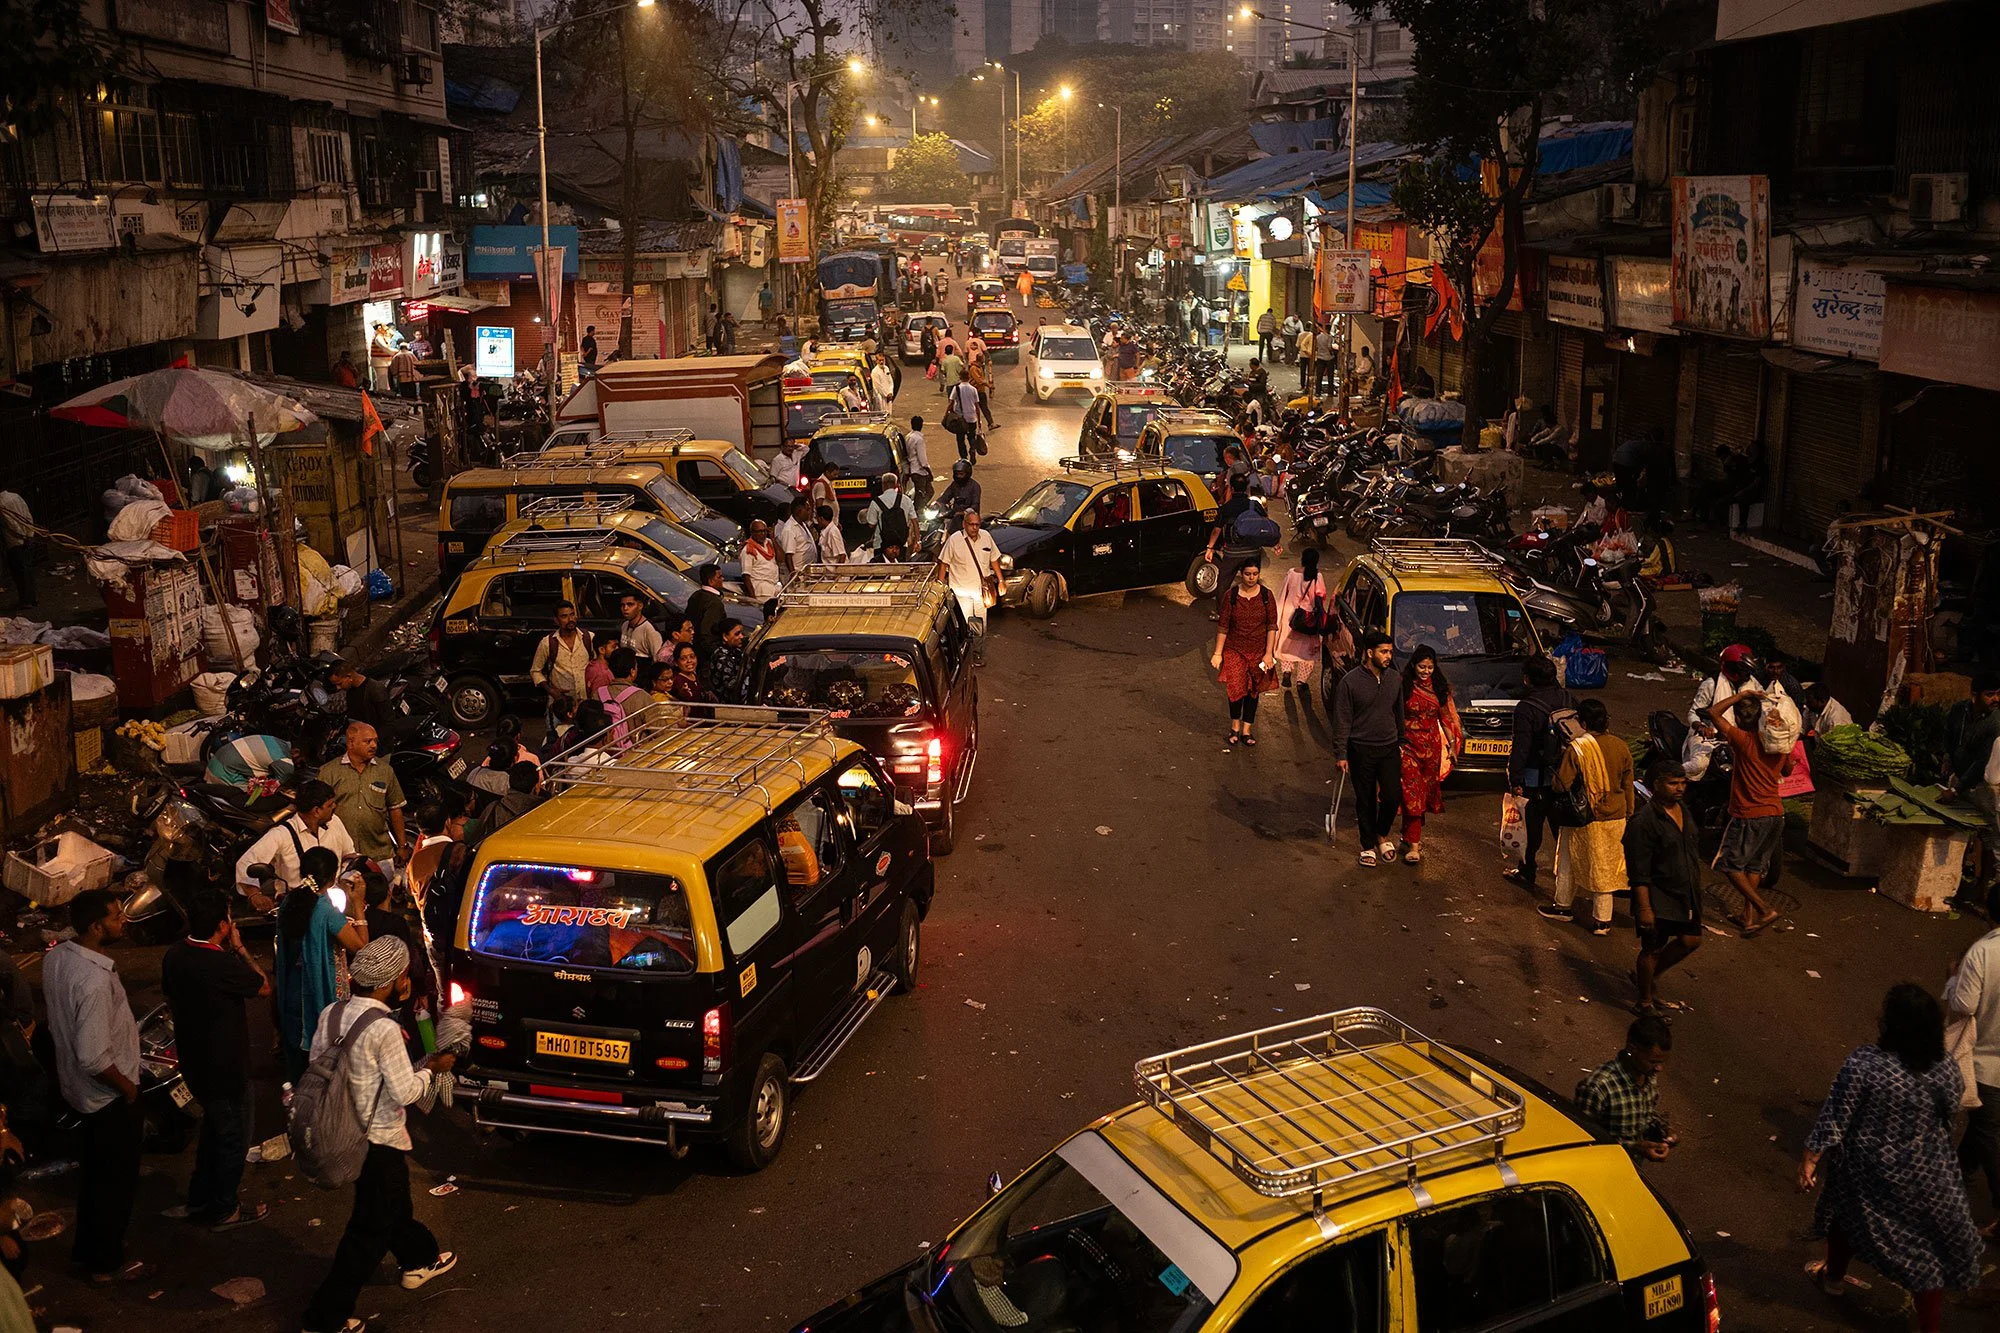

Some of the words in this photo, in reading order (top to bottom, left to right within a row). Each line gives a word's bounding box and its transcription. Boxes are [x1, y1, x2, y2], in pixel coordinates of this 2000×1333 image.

[1812, 293, 1861, 321] सुरेन्द्र
[291, 484, 331, 502] TATIONARY
[664, 1019, 695, 1029] EECO
[546, 1036, 629, 1060] MH01BT5957
